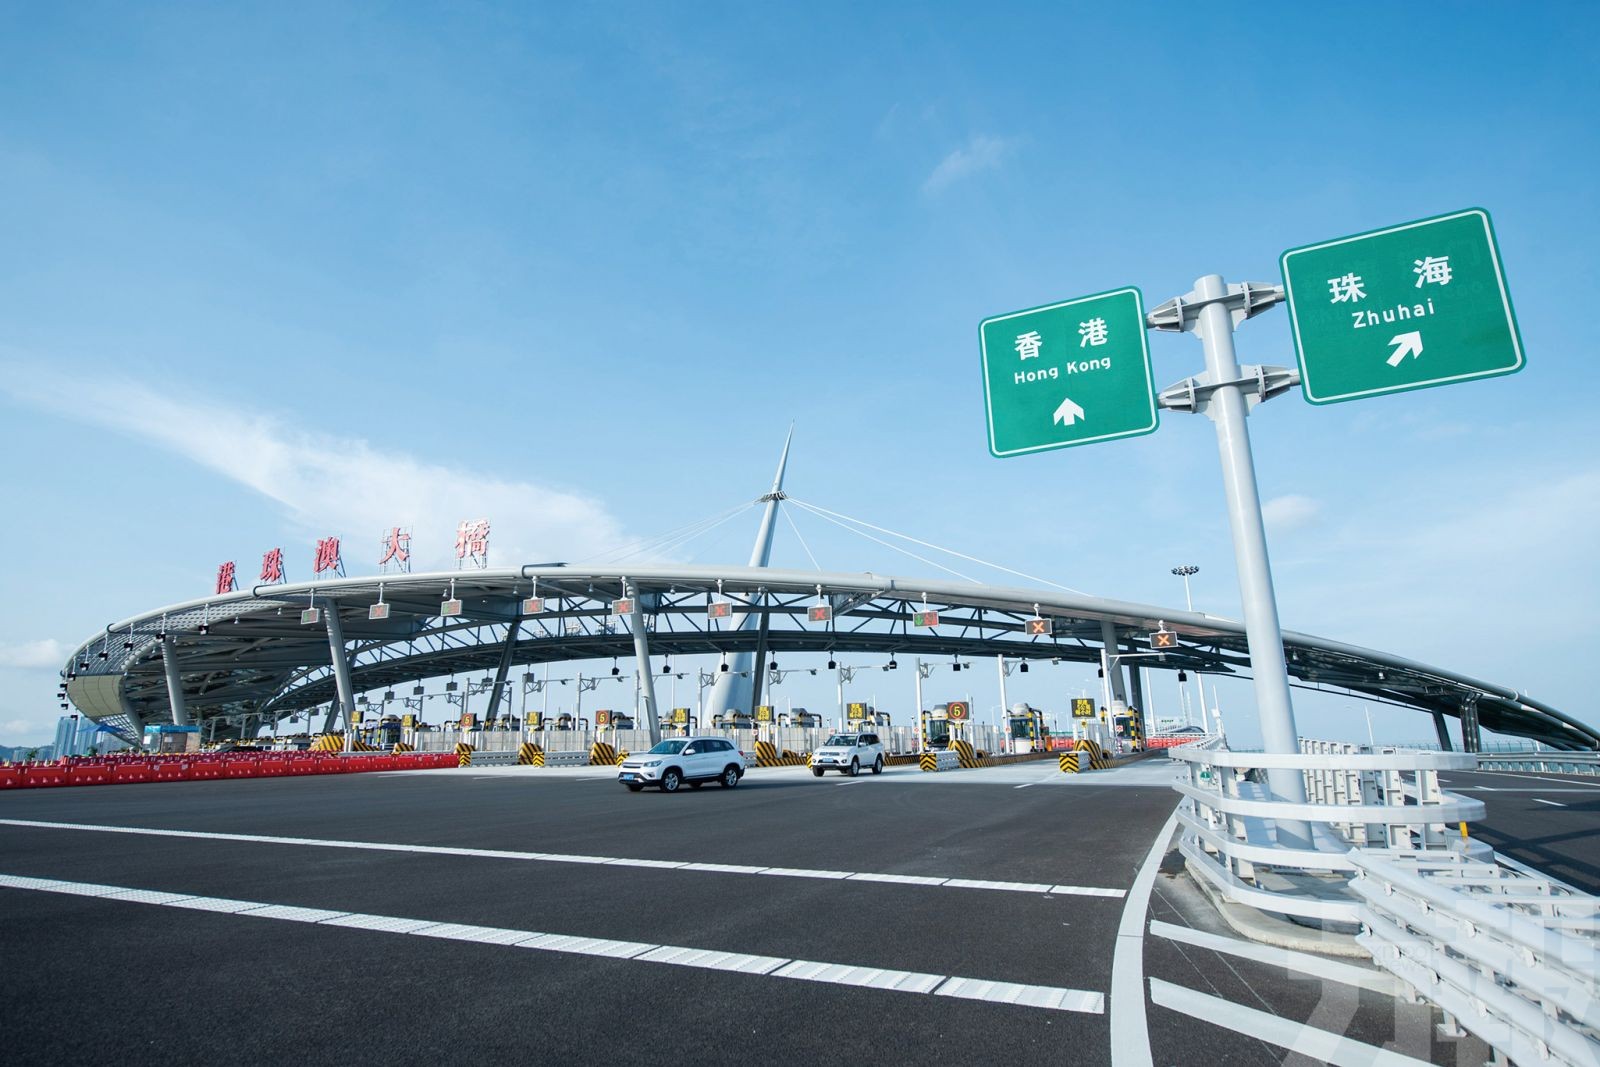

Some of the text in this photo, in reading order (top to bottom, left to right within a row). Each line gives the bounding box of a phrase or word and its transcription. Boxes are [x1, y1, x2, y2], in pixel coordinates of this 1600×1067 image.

[1327, 256, 1453, 304] 珠海
[1352, 298, 1435, 329] Zhuhai
[1014, 317, 1109, 361] 香港
[1014, 357, 1111, 385] Hong Kong
